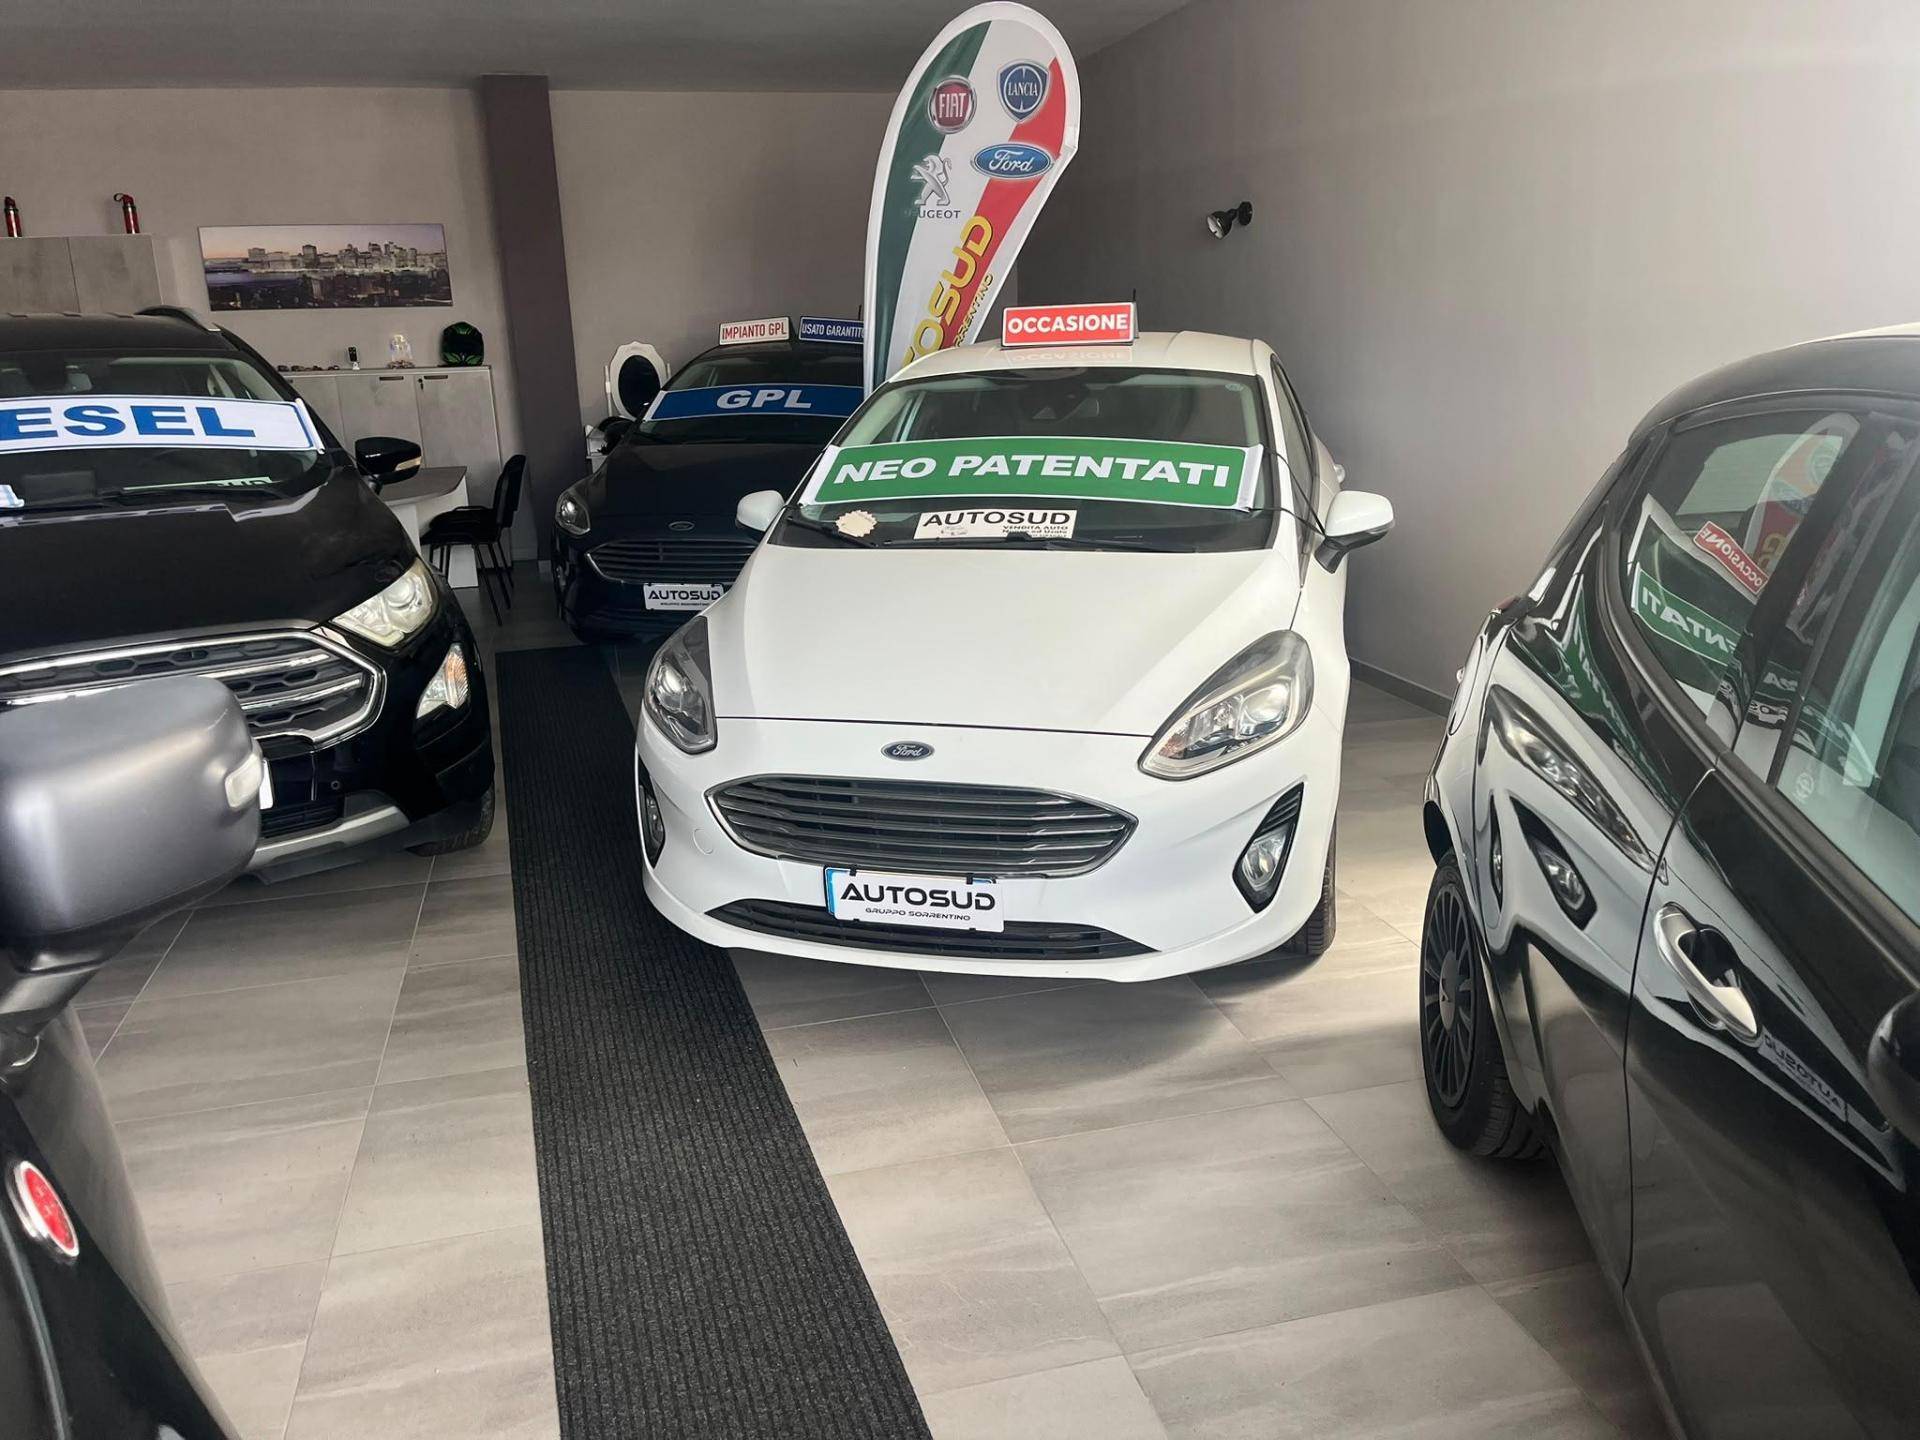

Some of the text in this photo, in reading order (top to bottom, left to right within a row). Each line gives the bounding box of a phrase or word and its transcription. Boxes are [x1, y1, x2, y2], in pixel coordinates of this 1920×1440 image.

[1007, 82, 1039, 96] LANCIA
[939, 93, 966, 118] FIAT
[988, 149, 1034, 172] Ford
[904, 208, 961, 219] UGEOT
[722, 321, 788, 339] IMPIANTO GPL
[801, 323, 824, 335] USATO
[1007, 313, 1129, 334] OCCASIONE
[716, 389, 813, 409] GPL
[834, 454, 1230, 487] NEO PATENTATI
[923, 511, 1070, 527] AUTOSUD
[648, 590, 720, 601] AUTOSUD
[892, 744, 923, 757] Ford
[841, 883, 995, 911] AUTOSUD
[866, 907, 971, 921] GRUPPO SORRENTINO
